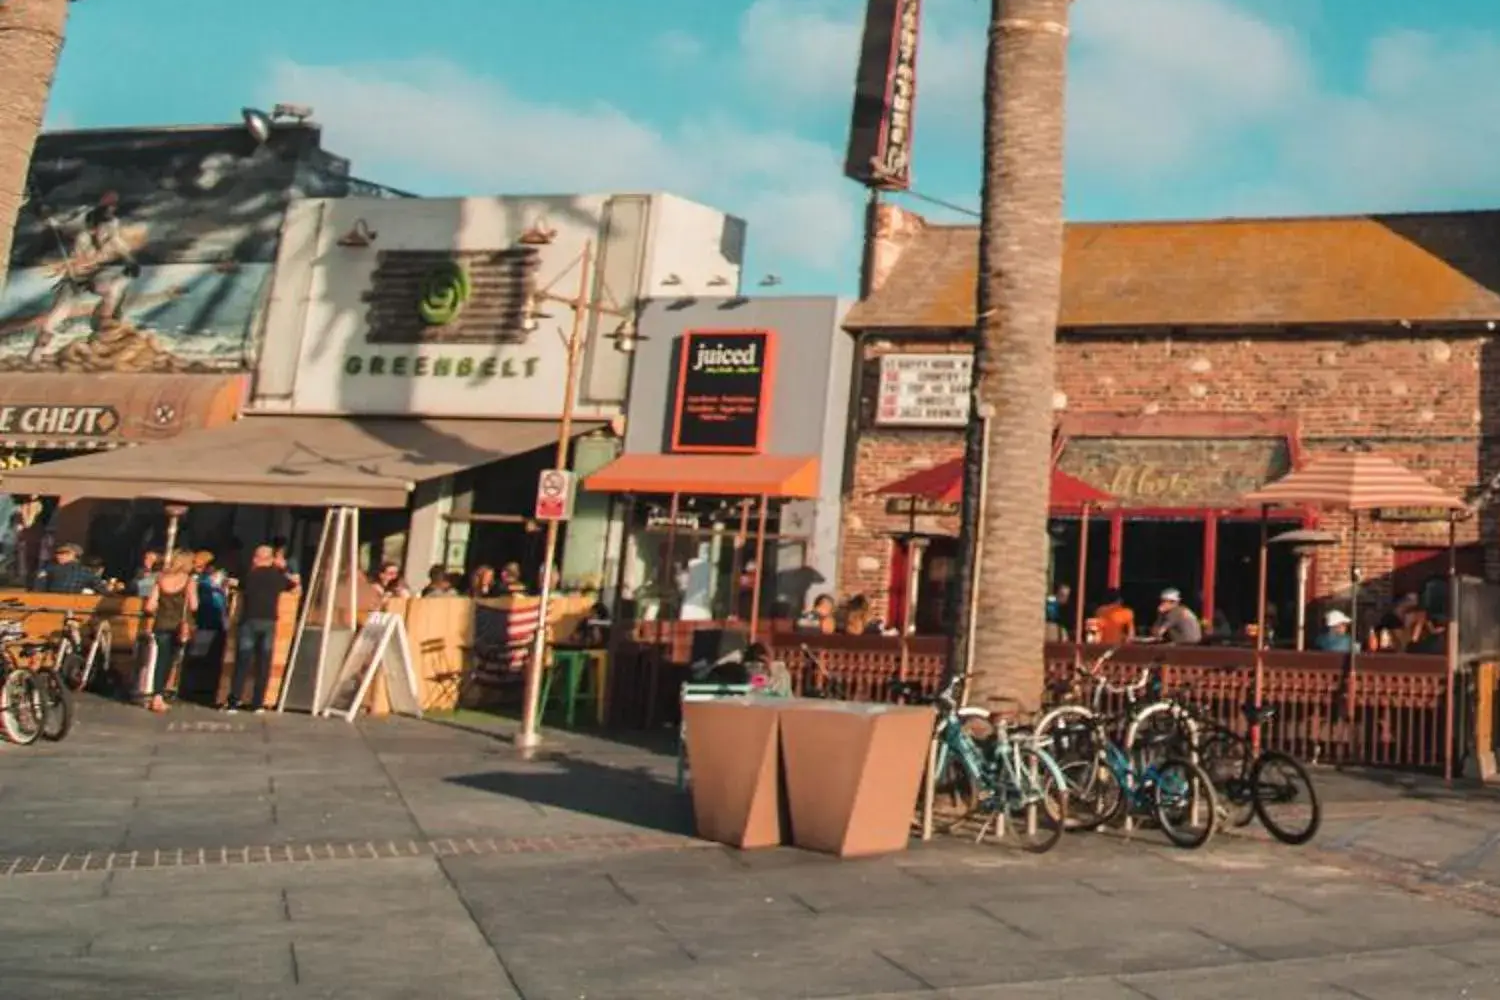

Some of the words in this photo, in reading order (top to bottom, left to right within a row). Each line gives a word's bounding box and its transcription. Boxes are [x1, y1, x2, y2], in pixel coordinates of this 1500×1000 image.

[345, 355, 540, 378] GREENBELT
[692, 343, 757, 371] juiced
[19, 406, 103, 434] CHEST
